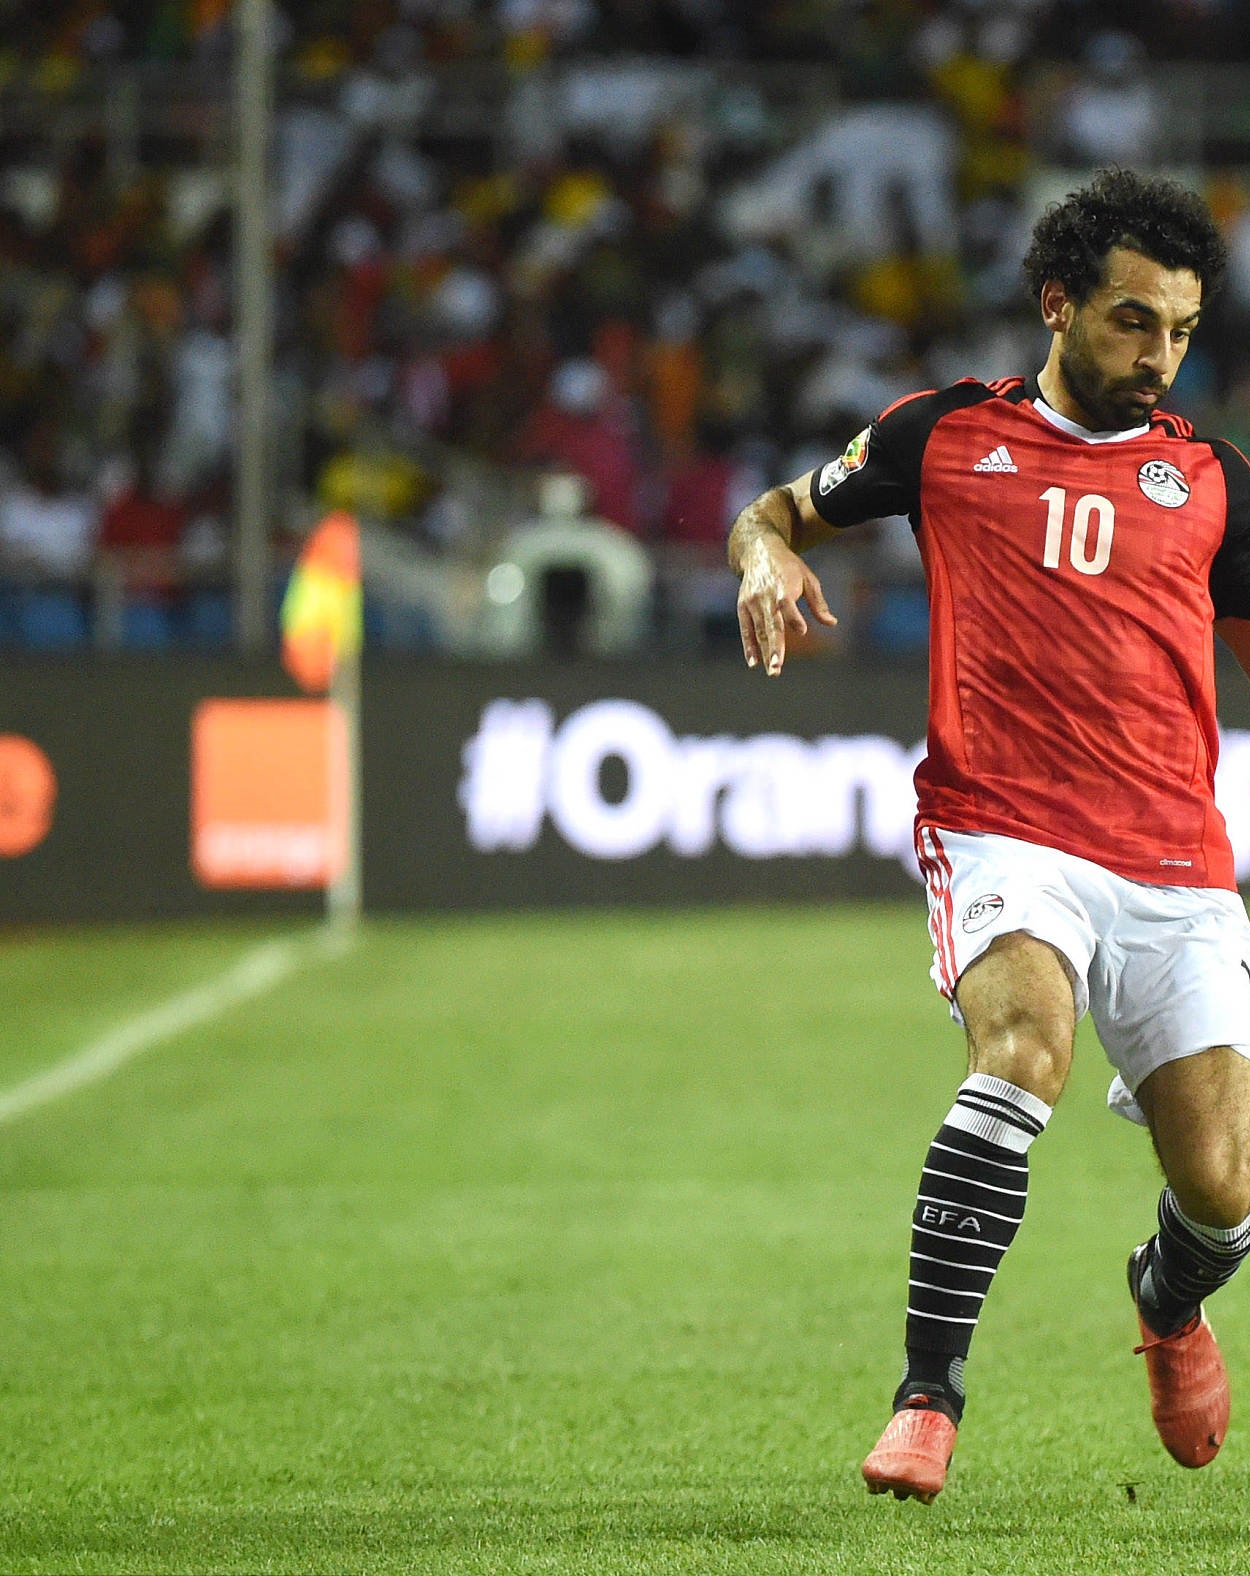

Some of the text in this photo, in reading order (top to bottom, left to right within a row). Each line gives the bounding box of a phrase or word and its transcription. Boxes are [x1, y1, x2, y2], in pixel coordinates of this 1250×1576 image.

[973, 462, 1018, 473] adidas
[1038, 486, 1116, 576] 10
[922, 1205, 981, 1233] EFA
